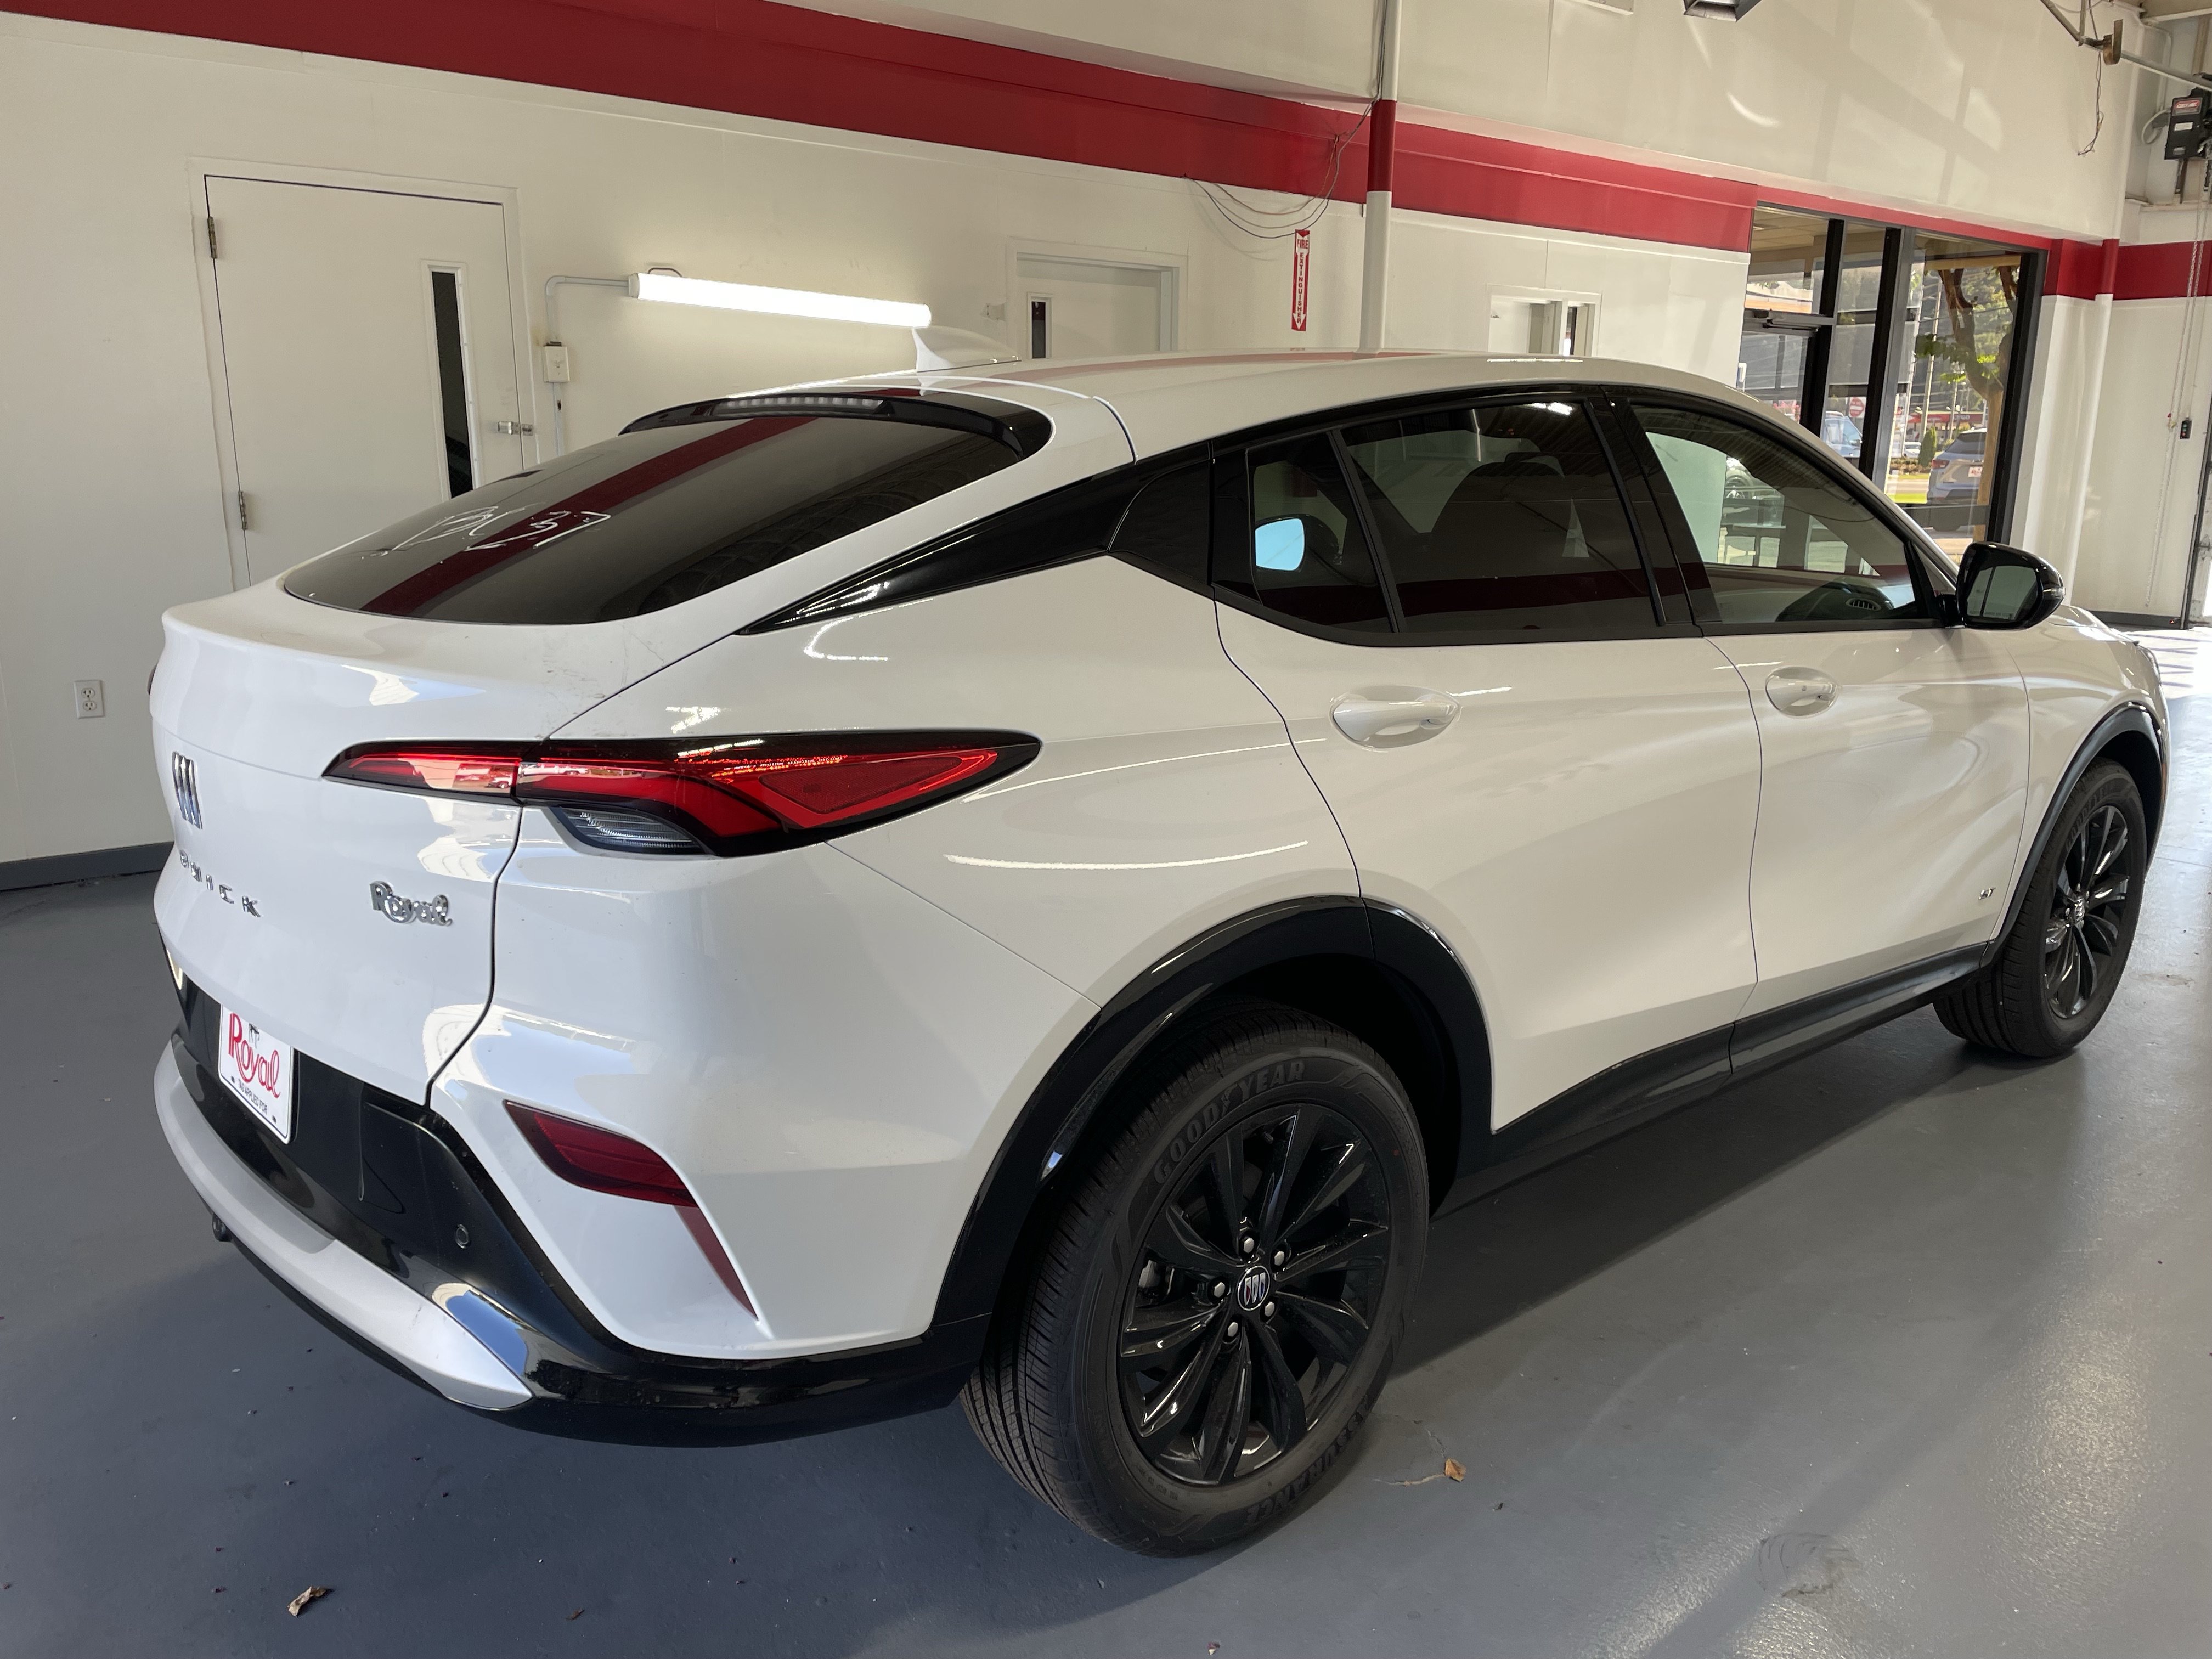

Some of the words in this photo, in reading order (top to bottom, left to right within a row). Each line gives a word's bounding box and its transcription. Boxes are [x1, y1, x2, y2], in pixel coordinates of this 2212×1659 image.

[1297, 239, 1309, 249] FIRE
[1296, 252, 1305, 324] EXTINGUISHER
[179, 849, 261, 918] BUICK
[369, 880, 453, 927] Royal
[228, 1013, 281, 1098] Royal
[245, 1086, 259, 1107] APPLIED
[259, 1099, 268, 1115] FOR
[1154, 1060, 1305, 1184] GOODYEAR
